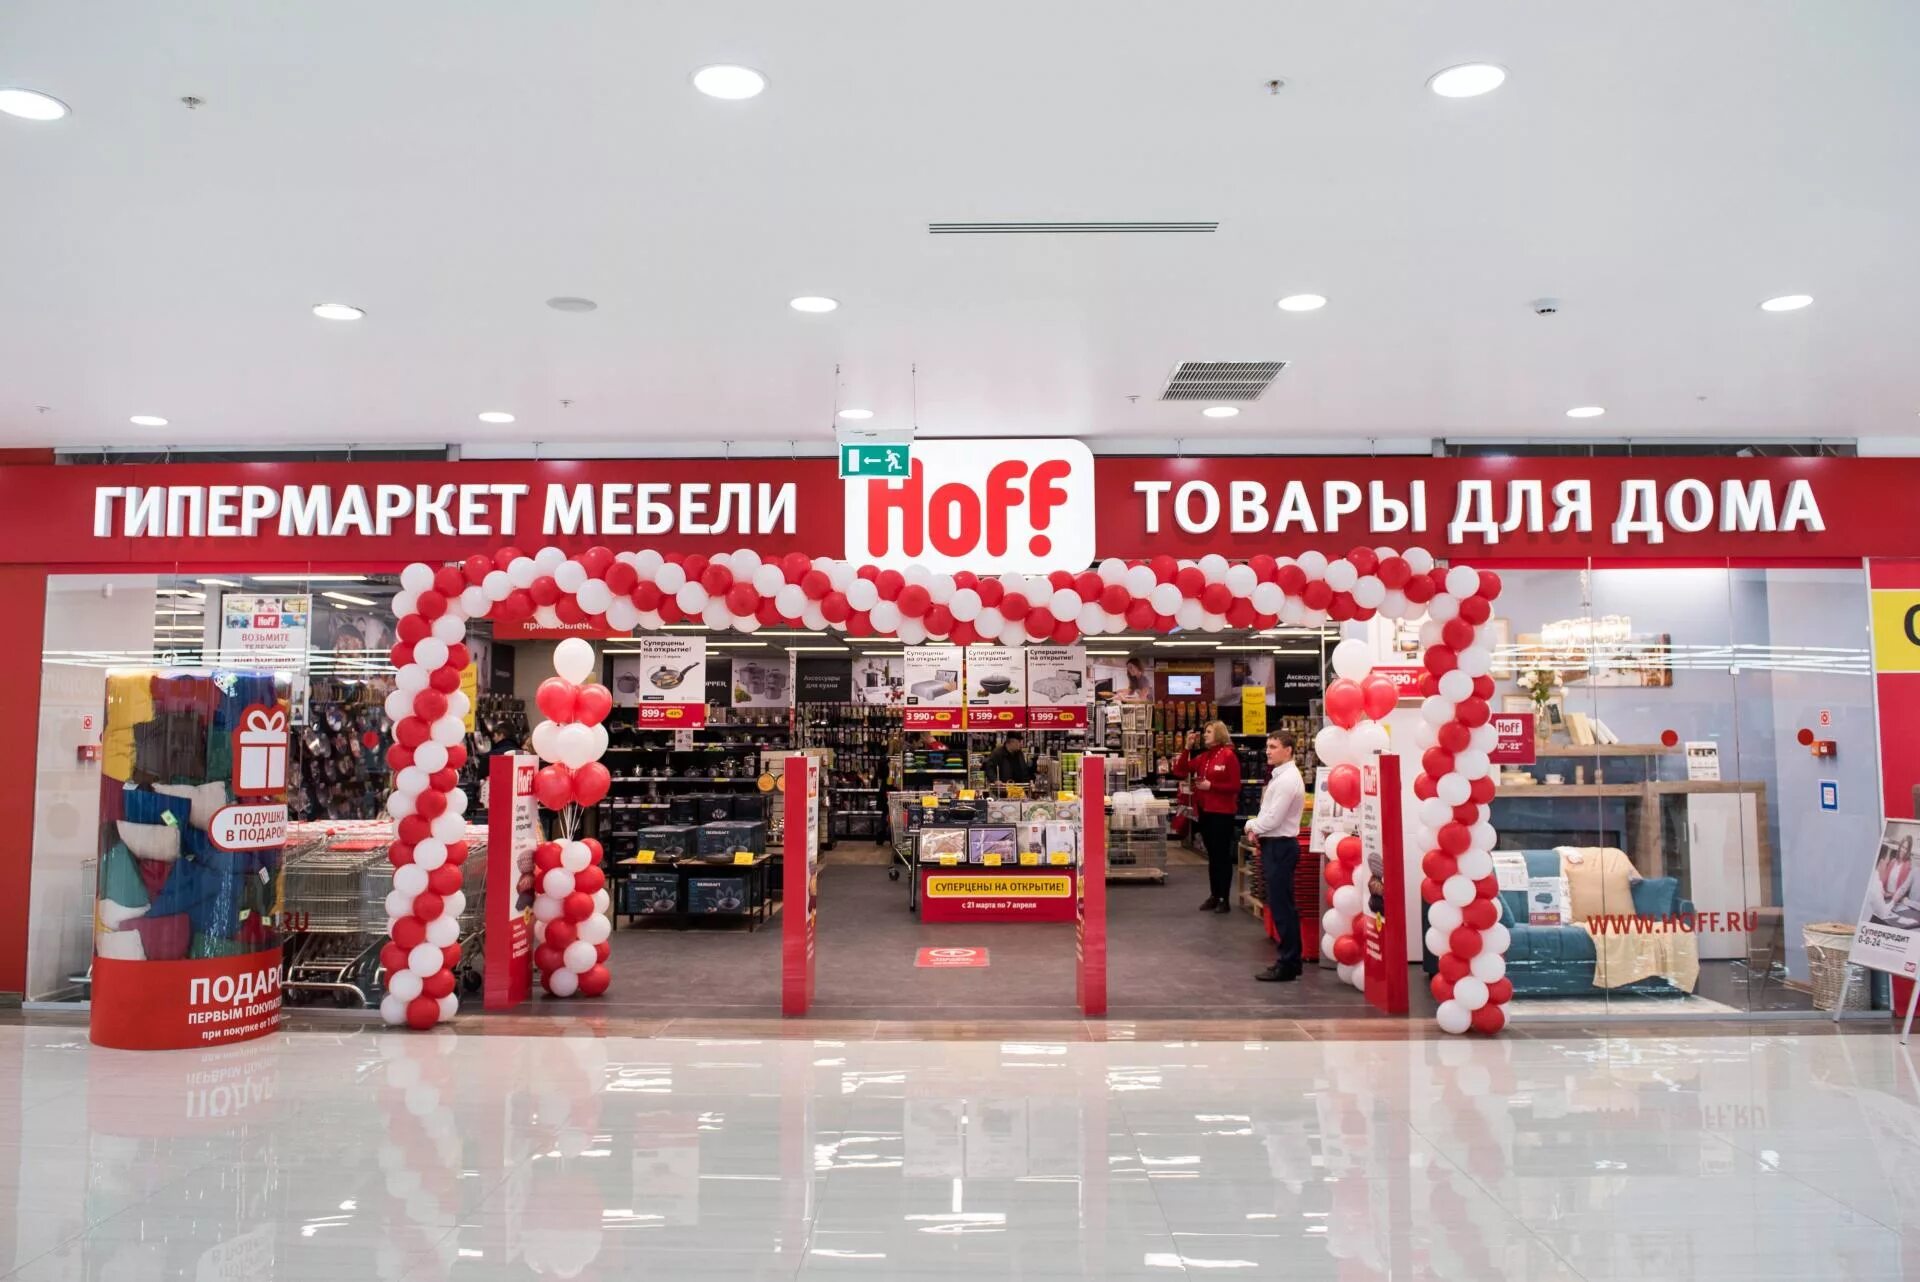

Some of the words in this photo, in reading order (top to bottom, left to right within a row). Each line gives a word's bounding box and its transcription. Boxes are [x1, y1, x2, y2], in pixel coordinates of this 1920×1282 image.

[94, 483, 529, 537] ГИПЕРМАРКЕТ
[543, 482, 796, 535] МЕБЕЛИ
[867, 457, 1071, 557] Hoff
[1134, 480, 1427, 534] ТОВАРЫ
[1447, 479, 1593, 544] ДЛЯ
[1611, 478, 1826, 544] ДОМА
[241, 633, 289, 641] ВОЗЬМИТЕ
[643, 640, 685, 648] Суперцены
[641, 708, 660, 718] 899
[906, 712, 912, 721] 3
[913, 712, 930, 721] 990
[969, 712, 974, 720] 1
[976, 712, 993, 720] 599
[1037, 712, 1054, 720] 999
[1498, 722, 1521, 733] Hoff
[226, 830, 234, 841] В
[935, 882, 992, 893] СУПЕРЦЕНЫ
[994, 882, 1007, 892] НА
[1009, 882, 1065, 892] ОТКРЫТИЕ!
[976, 902, 996, 910] марта
[1012, 902, 1037, 910] апреля
[1587, 911, 1759, 935] WWW.HOFF.RU
[1861, 925, 1911, 943] Суперкредит
[188, 1004, 243, 1025] ПЕРВЫМ
[202, 1030, 221, 1041] при
[223, 1022, 259, 1036] покупке
[259, 1020, 267, 1030] от
